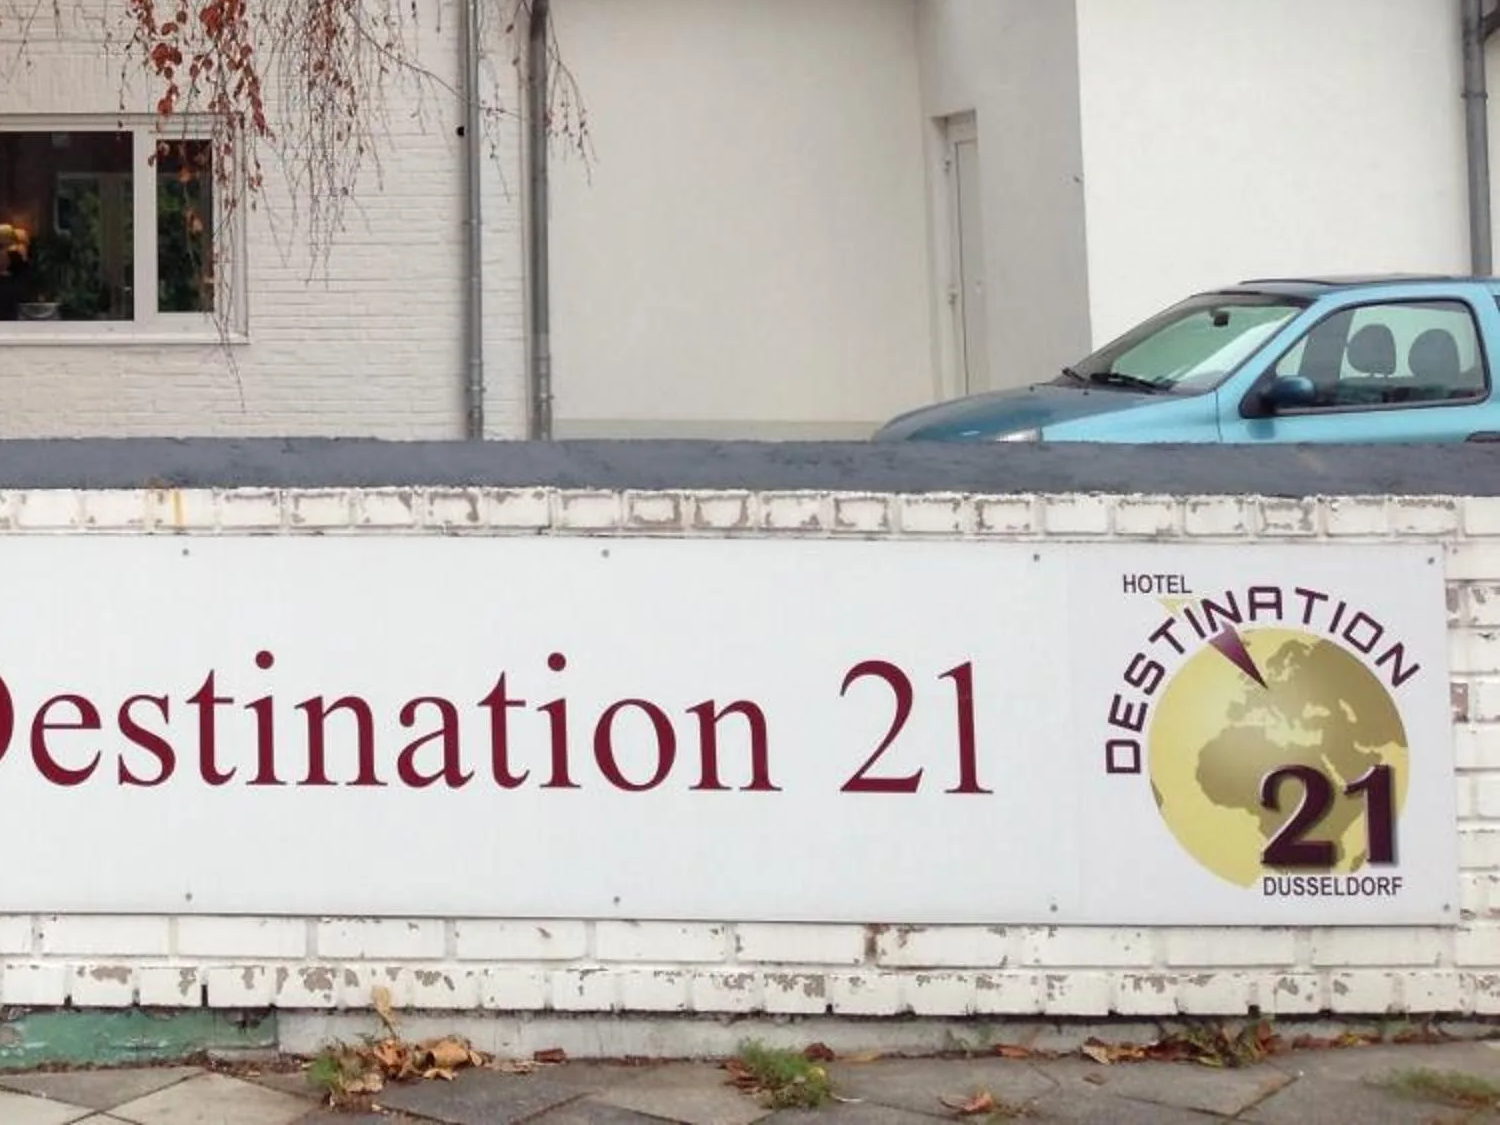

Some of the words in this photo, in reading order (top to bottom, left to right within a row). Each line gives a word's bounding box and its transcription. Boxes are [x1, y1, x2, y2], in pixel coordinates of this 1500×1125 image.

[1122, 574, 1193, 594] HOTEL
[839, 660, 994, 795] 21
[1105, 586, 1420, 774] DESTINATION
[1259, 764, 1399, 869] 21
